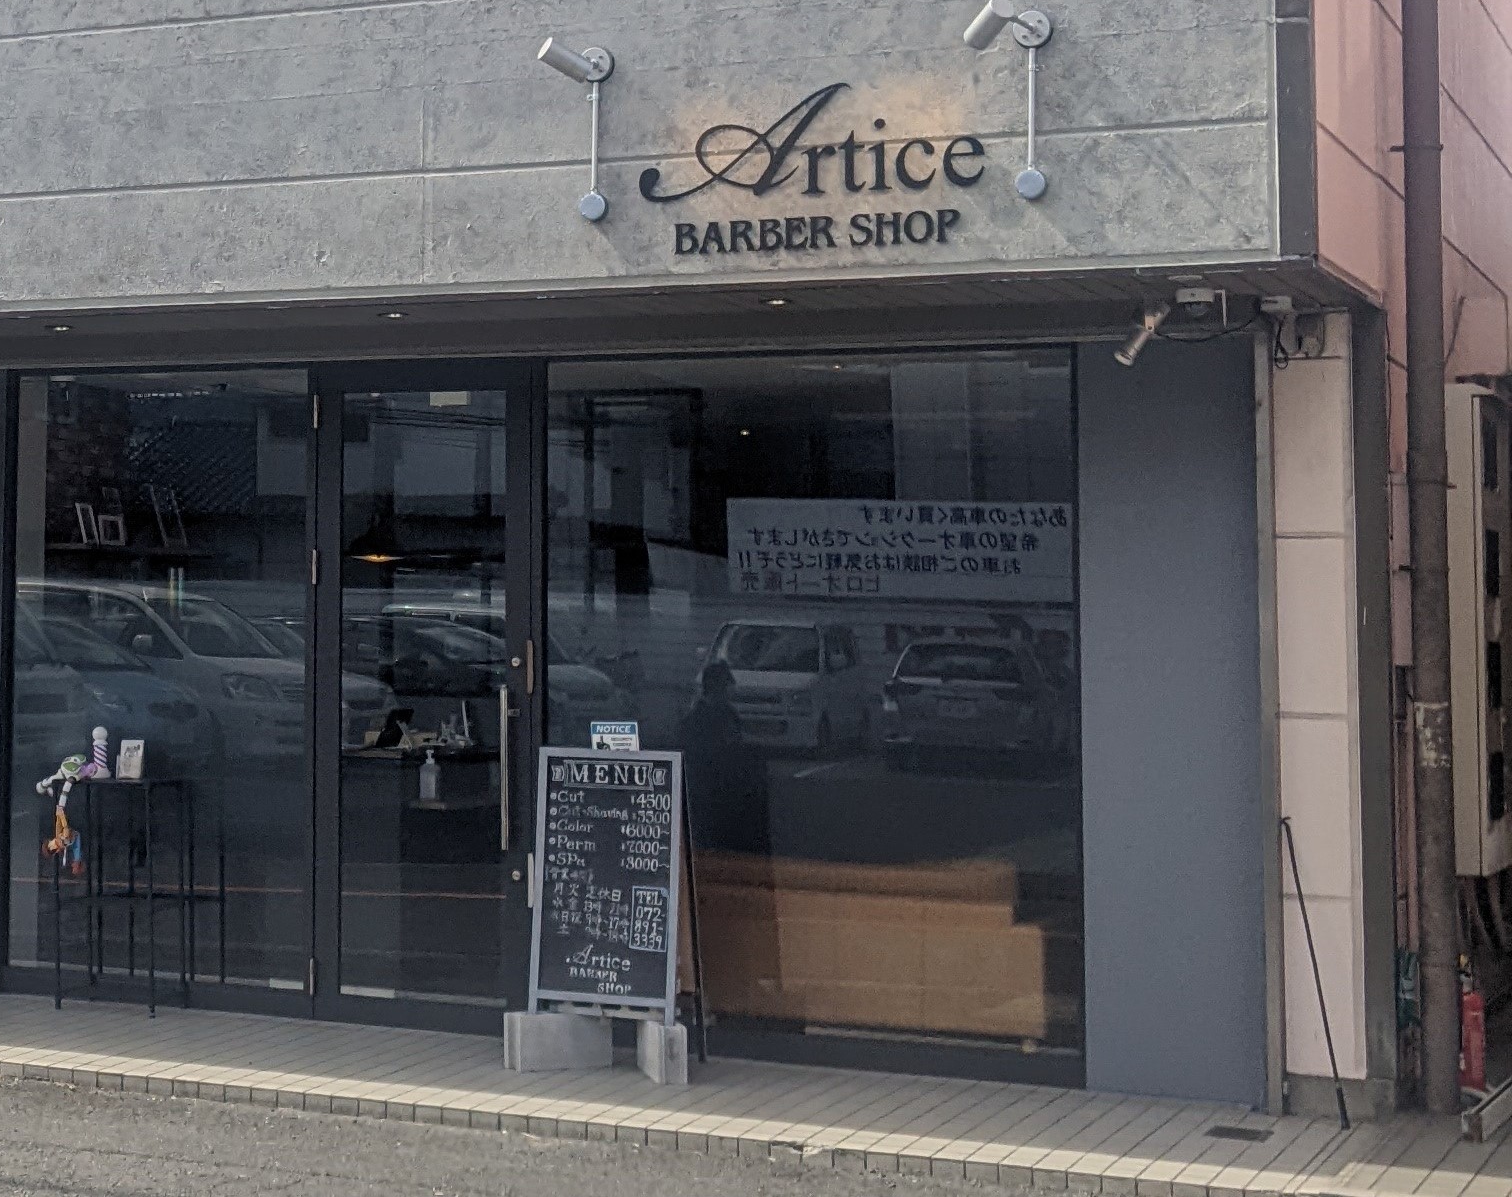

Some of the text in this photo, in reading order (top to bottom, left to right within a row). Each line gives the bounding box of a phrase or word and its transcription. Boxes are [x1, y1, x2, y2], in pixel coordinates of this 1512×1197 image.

[639, 82, 987, 203] Artice
[674, 208, 962, 256] BARBER SHOP
[596, 724, 633, 734] NOTICE
[569, 763, 650, 786] MENU
[557, 789, 585, 804] Cut
[556, 820, 595, 835] Color
[556, 834, 597, 853] Perm
[636, 891, 663, 906] TEL
[565, 944, 631, 972] Artice
[597, 981, 632, 995] SHOP
